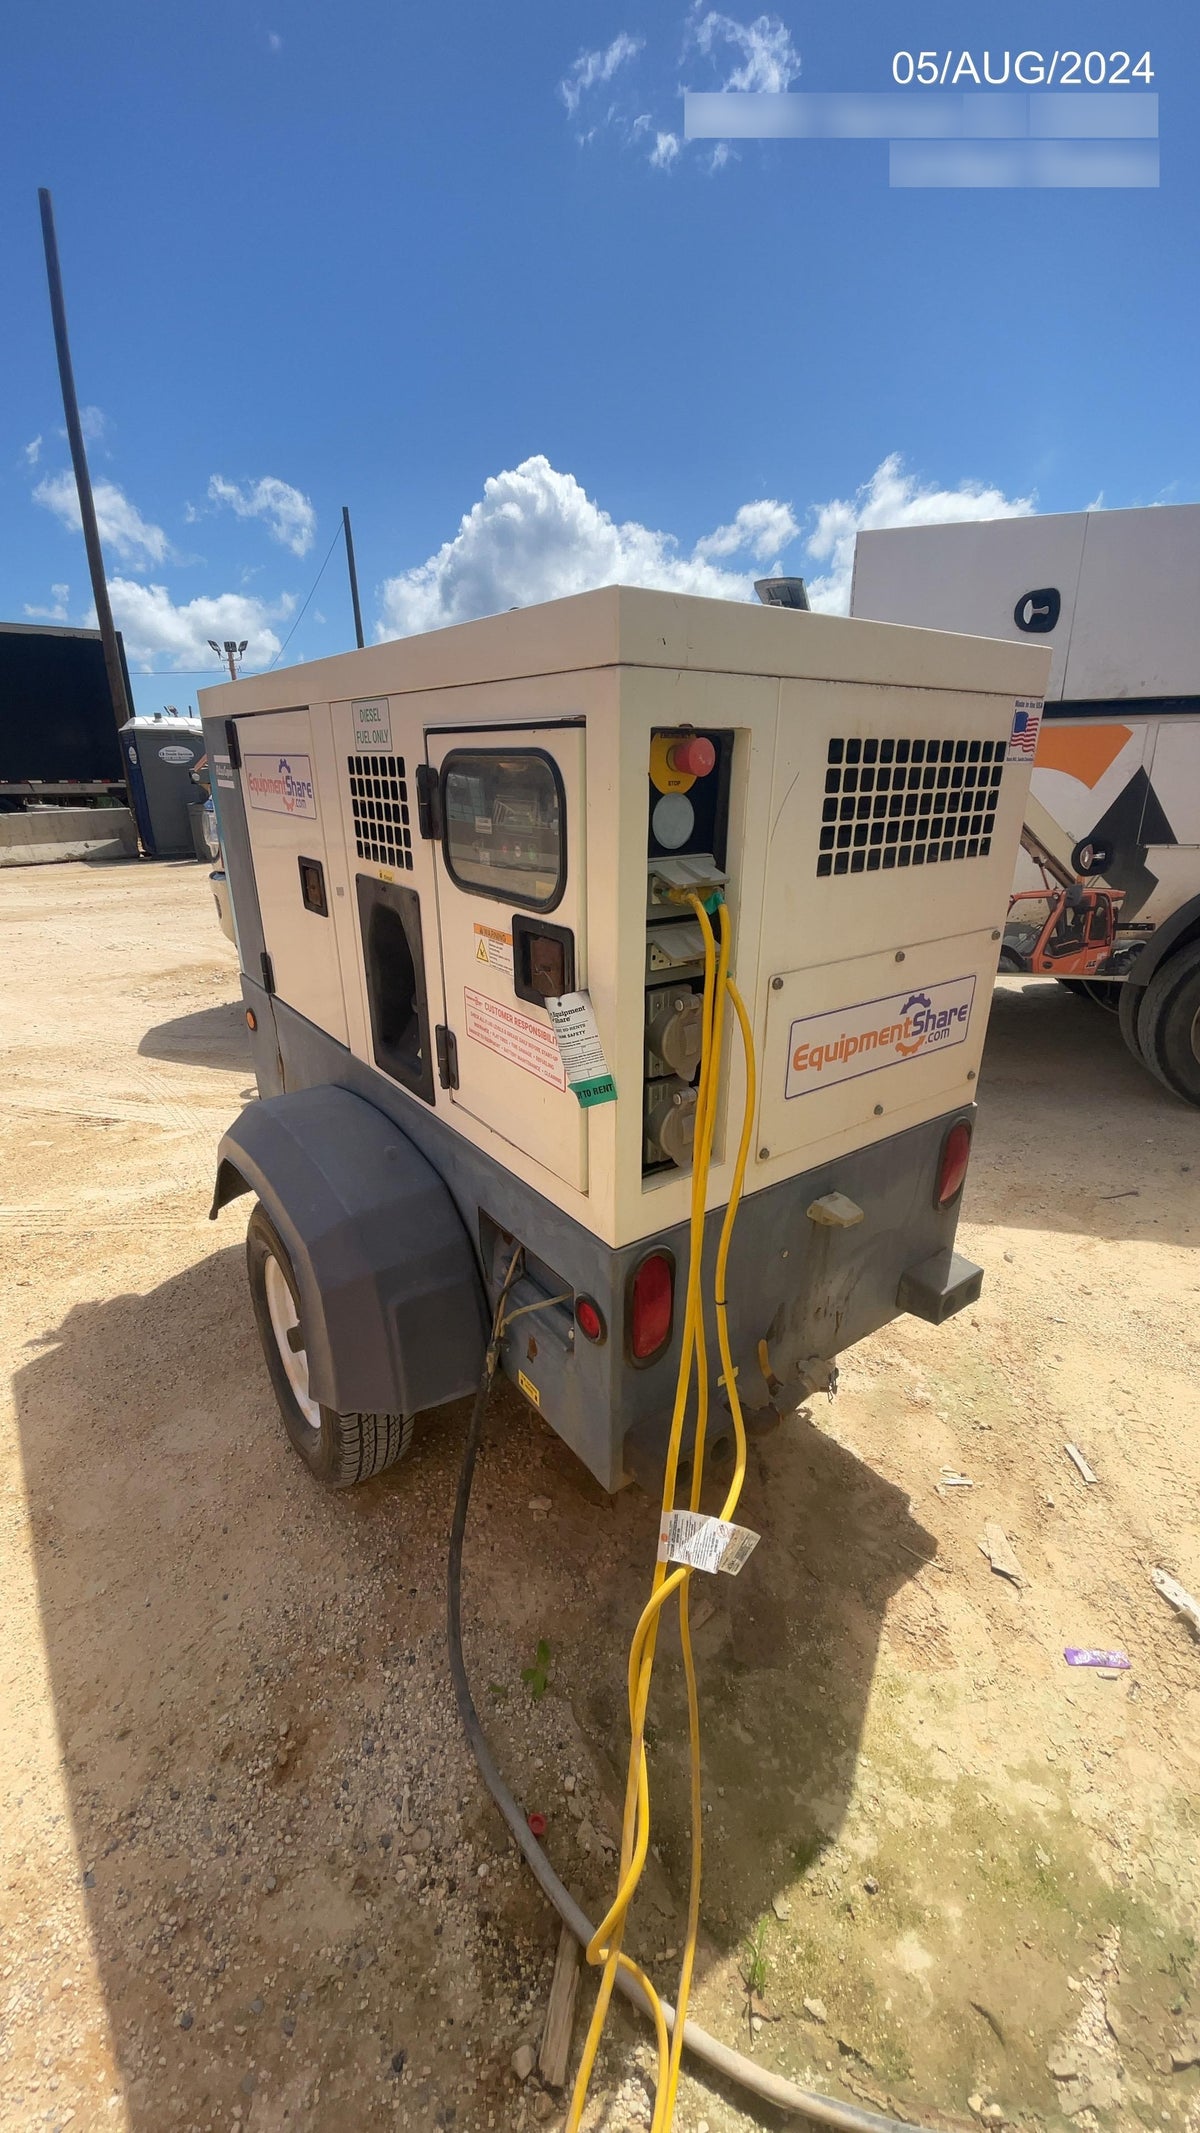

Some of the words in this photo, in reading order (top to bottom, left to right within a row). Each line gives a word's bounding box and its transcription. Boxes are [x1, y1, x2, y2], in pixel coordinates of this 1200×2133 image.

[359, 708, 381, 723] DIESEL
[356, 731, 371, 744] FUEL
[372, 729, 389, 744] ONLY
[249, 773, 312, 799] EquipmentShare
[484, 1002, 514, 1025] CUSTOMER
[793, 1004, 969, 1071] EquipmentShare
[924, 1026, 950, 1045] .com
[581, 1089, 591, 1098] TO
[593, 1084, 613, 1095] RENT
